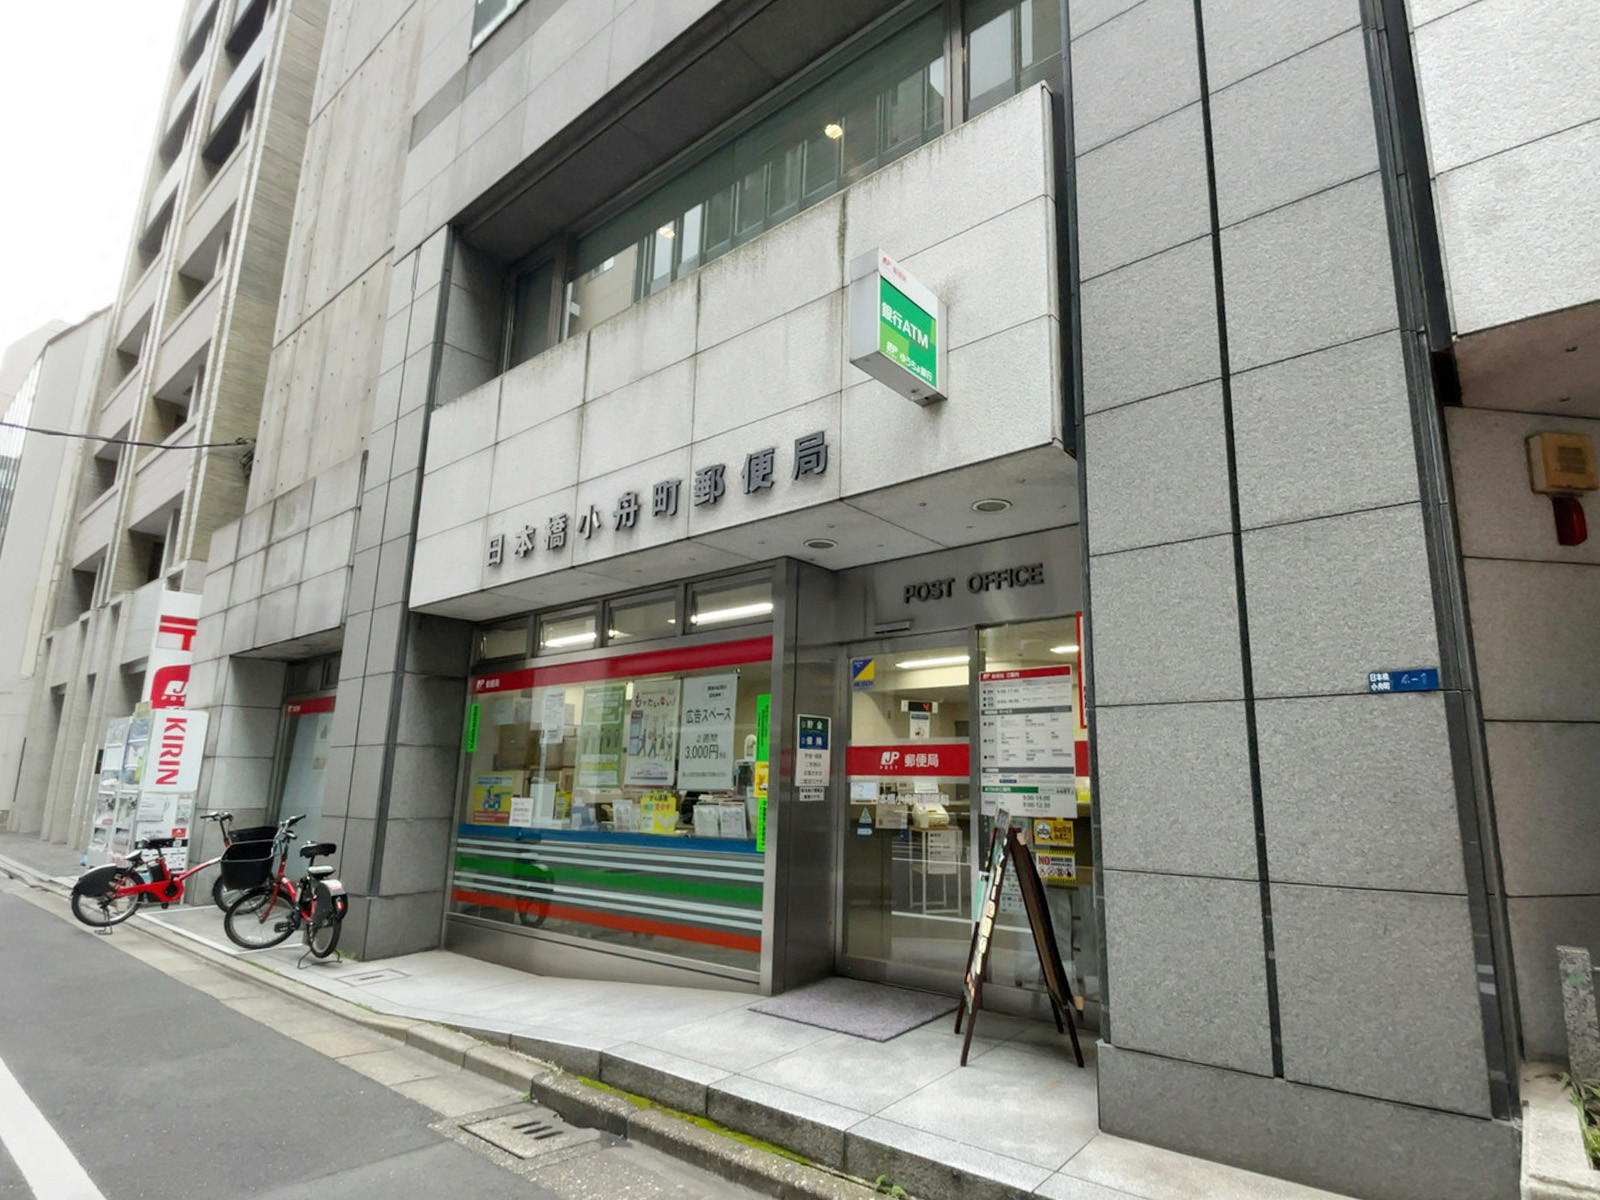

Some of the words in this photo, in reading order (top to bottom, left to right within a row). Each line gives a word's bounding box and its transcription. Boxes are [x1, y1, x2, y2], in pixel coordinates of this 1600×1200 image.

[881, 301, 929, 350] 銀行ATM
[486, 431, 829, 568] 日本橋小舟町郵便局
[904, 577, 956, 604] POST
[967, 562, 1045, 594] OFFICE
[1370, 672, 1390, 682] 日本橋
[685, 707, 733, 724] 広告スペース
[155, 717, 188, 786] KIRIN
[684, 744, 719, 760] 3,000円
[904, 753, 939, 768] 郵便局
